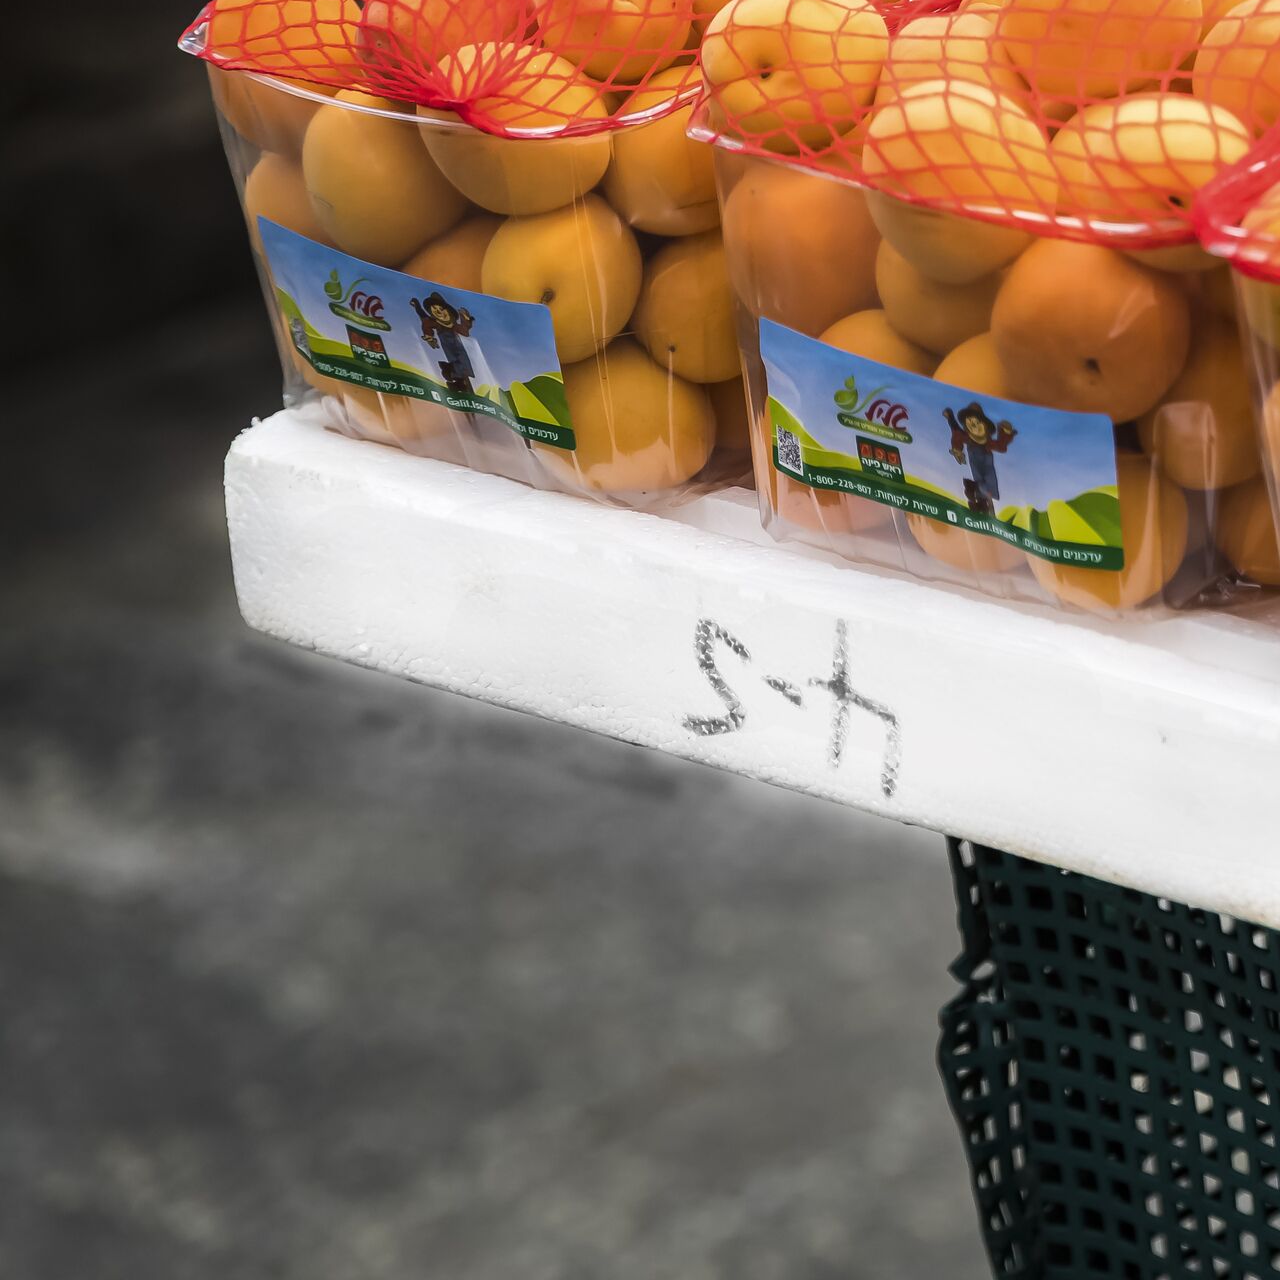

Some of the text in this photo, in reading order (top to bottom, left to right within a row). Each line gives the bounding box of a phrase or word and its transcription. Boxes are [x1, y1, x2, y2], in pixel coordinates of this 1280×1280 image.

[862, 457, 881, 468] פינה
[882, 462, 902, 476] ראש
[807, 473, 872, 496] 1-800-228-807
[875, 490, 909, 506] לקוחות:
[912, 501, 938, 515] שירות
[965, 516, 1017, 543] Galil.Israel
[1063, 549, 1103, 563] עדכונים
